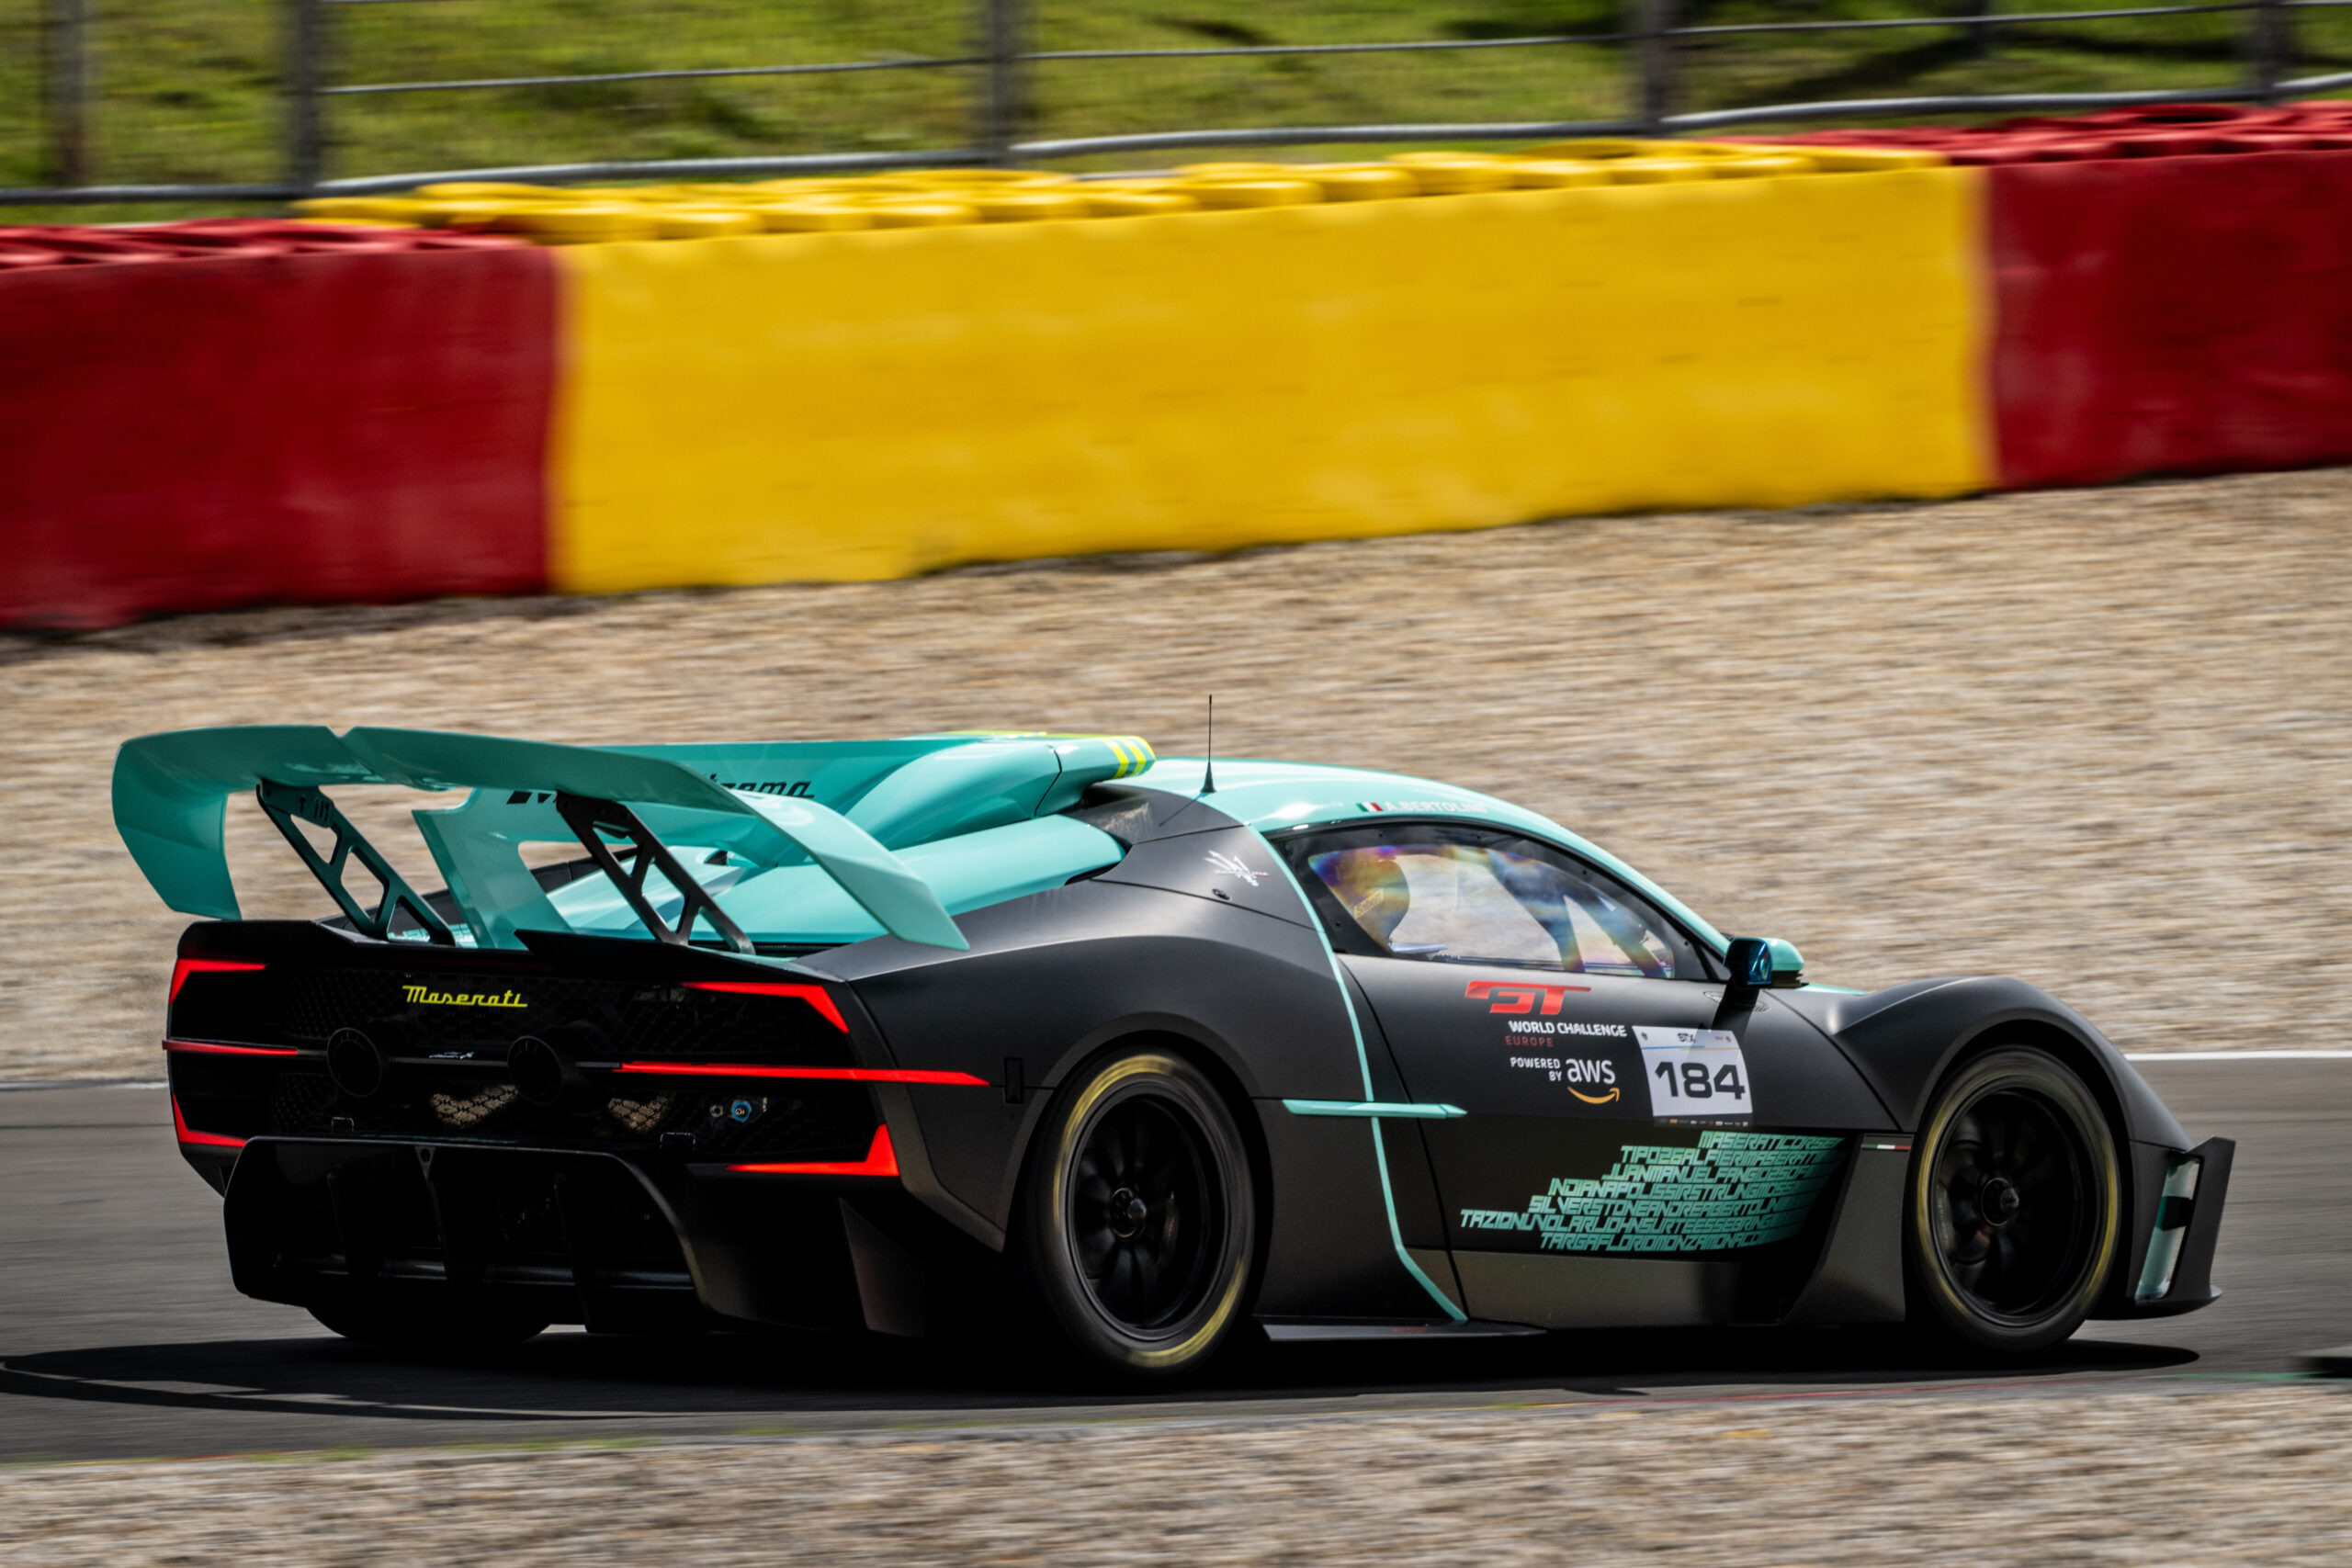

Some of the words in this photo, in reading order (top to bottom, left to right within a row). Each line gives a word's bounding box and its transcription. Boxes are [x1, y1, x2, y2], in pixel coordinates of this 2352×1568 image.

[402, 985, 528, 1008] Maserati
[1464, 980, 1591, 1015] GT
[1508, 1021, 1555, 1033] WORLD
[1556, 1022, 1627, 1037] CHALLENGE
[1505, 1035, 1554, 1047] EUROPE
[1510, 1057, 1561, 1069] POWERED
[1566, 1058, 1616, 1085] aws
[1548, 1071, 1562, 1081] BY
[1655, 1061, 1746, 1100] 184
